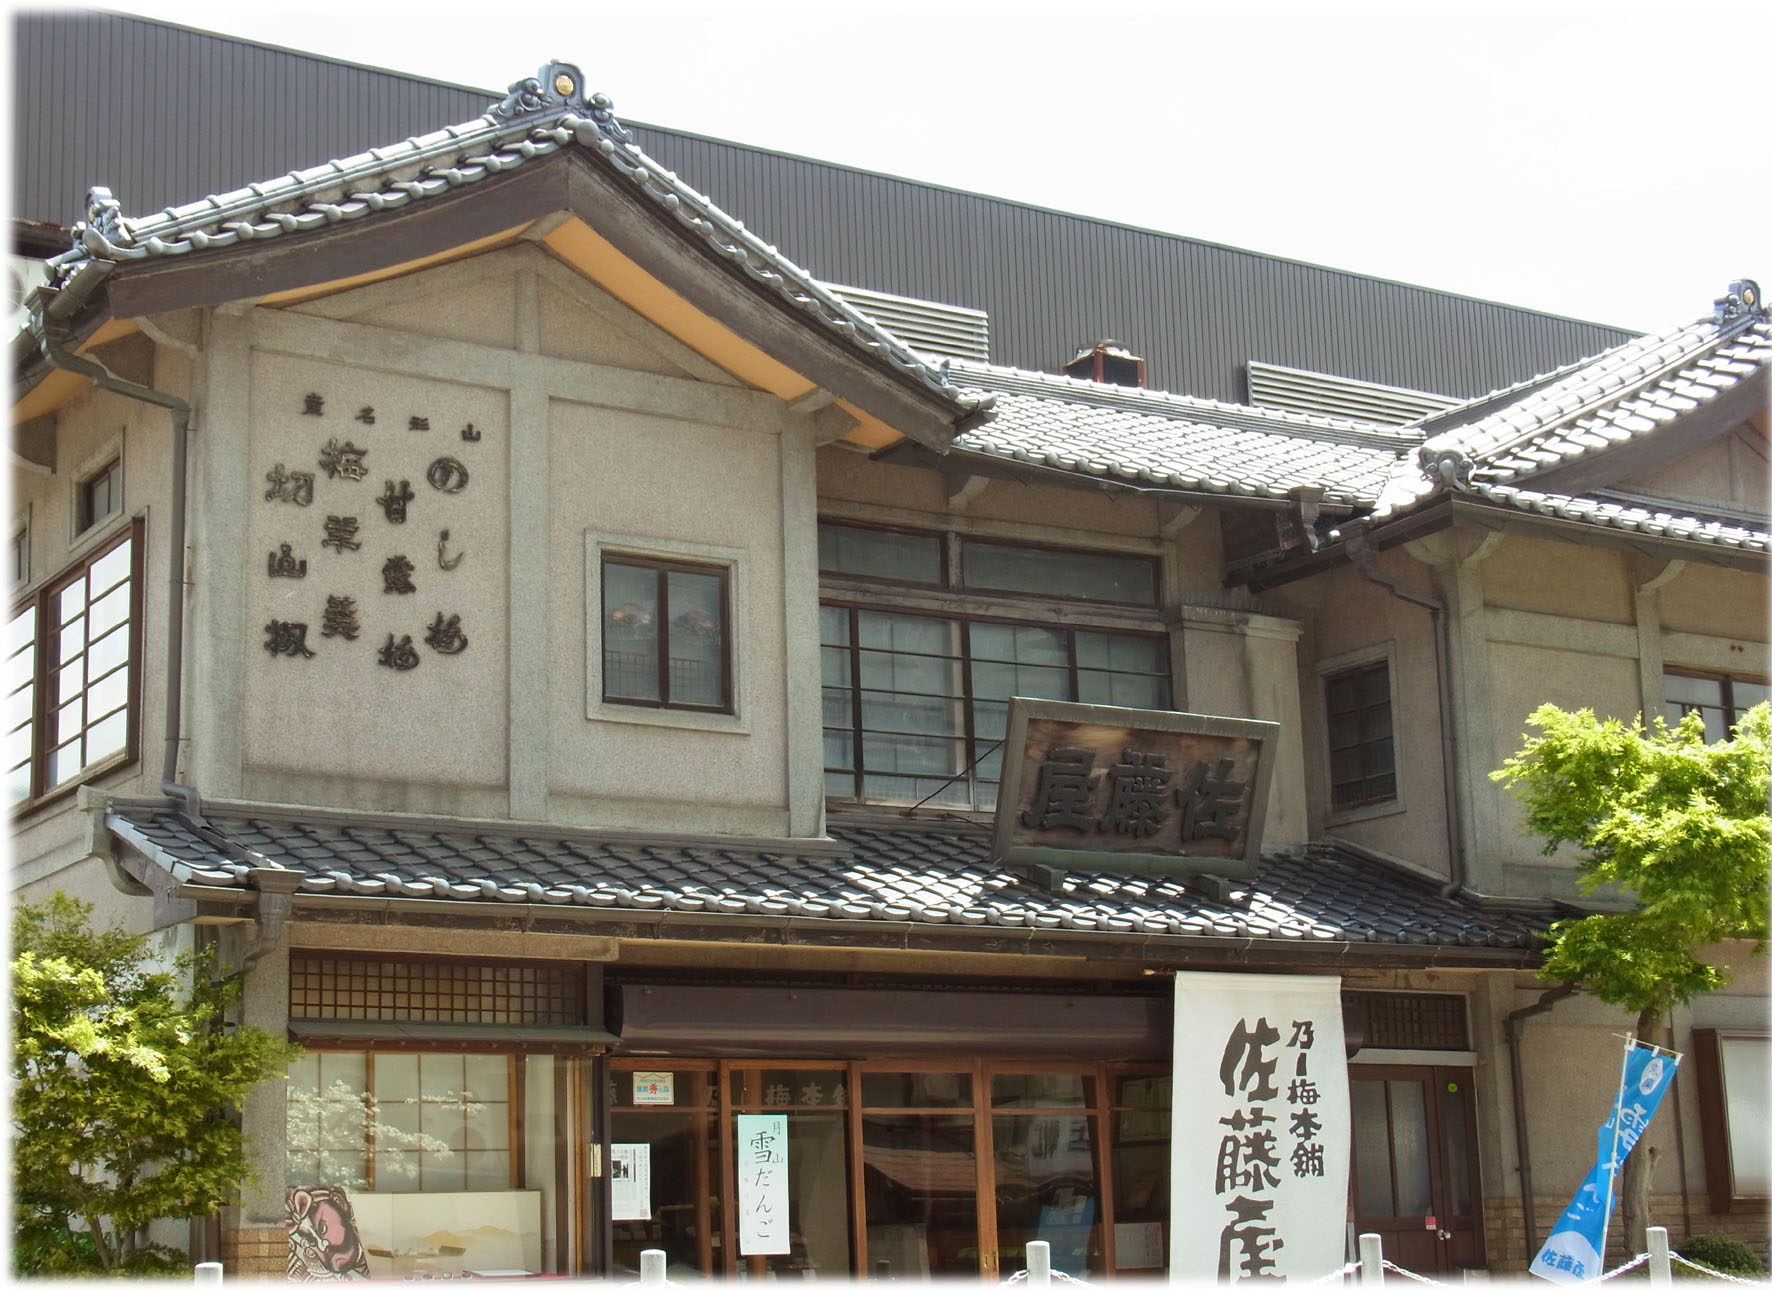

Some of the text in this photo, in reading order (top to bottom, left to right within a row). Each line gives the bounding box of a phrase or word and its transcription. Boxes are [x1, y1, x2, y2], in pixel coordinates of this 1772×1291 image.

[1020, 746, 1250, 841] 佐藤屋
[750, 1131, 776, 1238] 雪だんご
